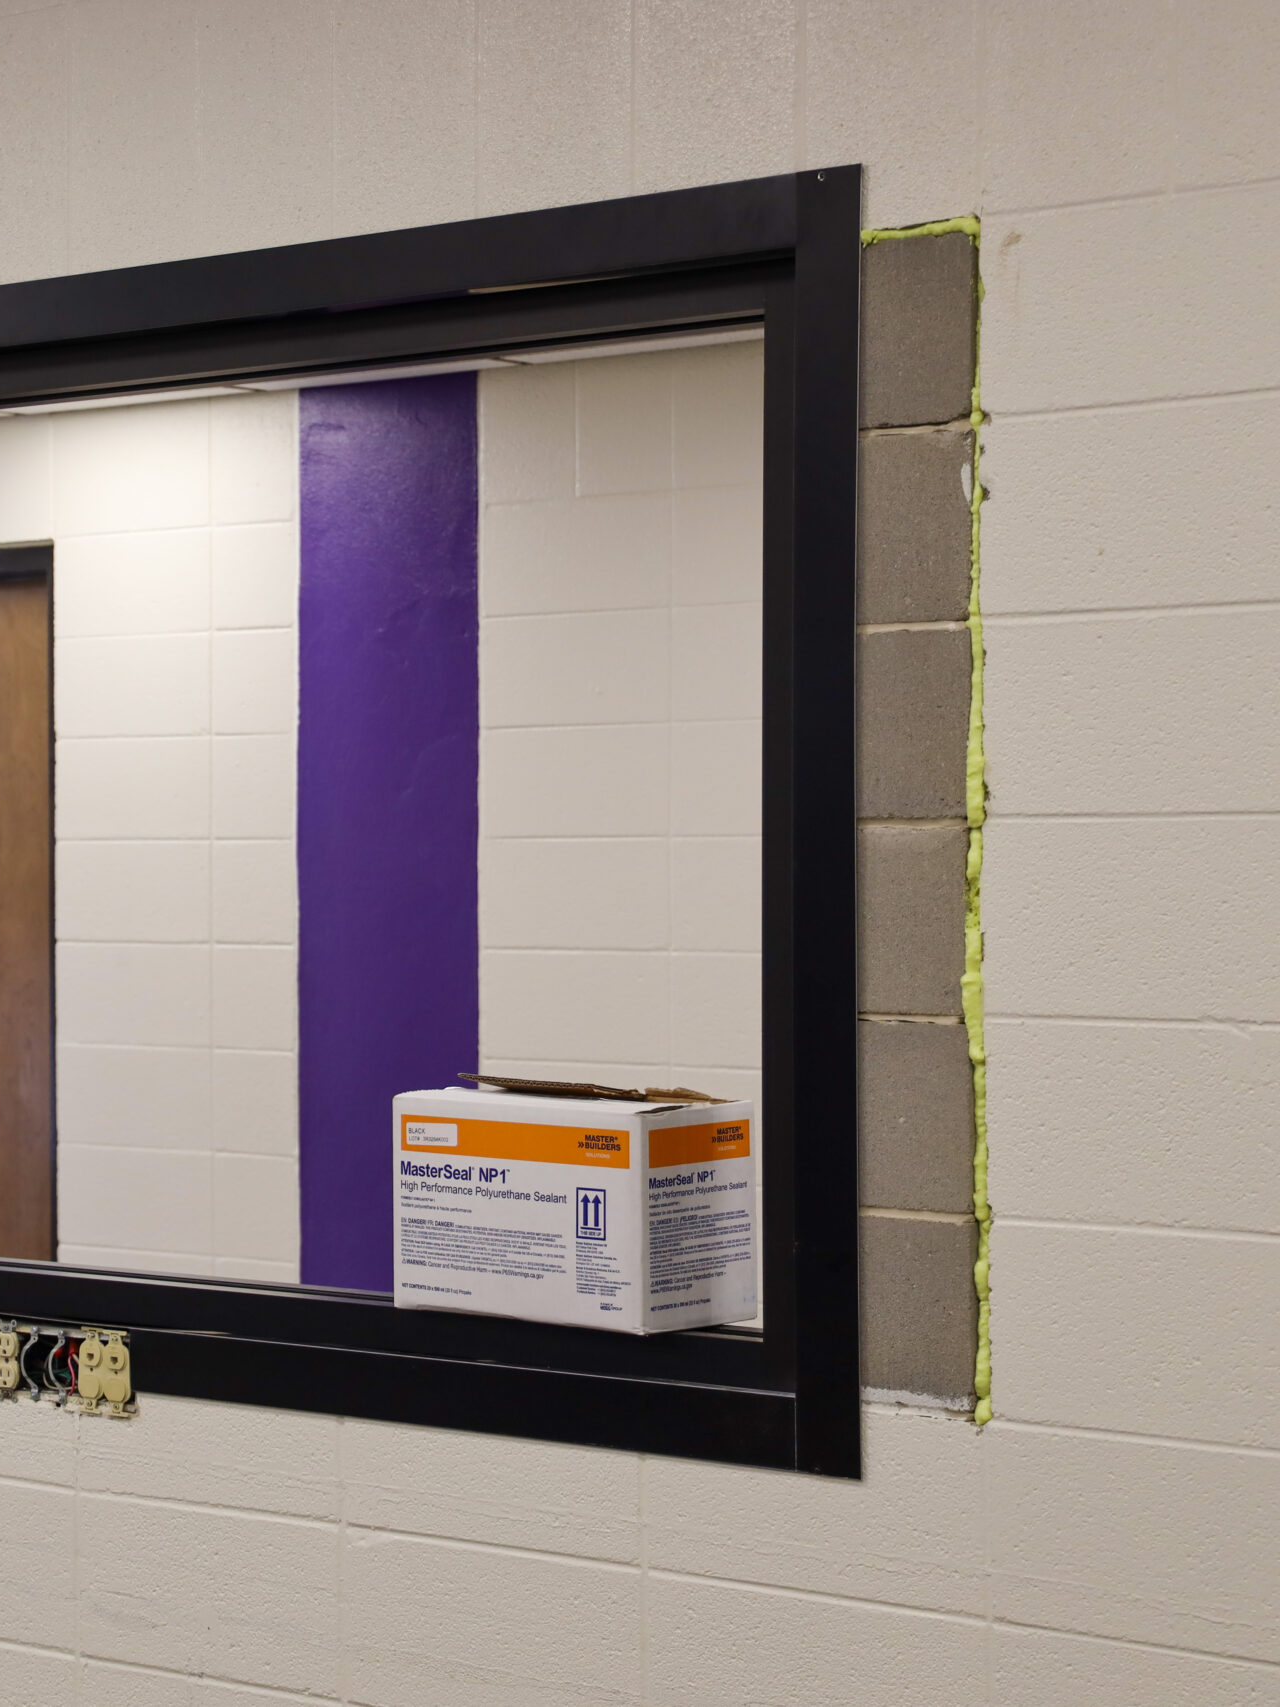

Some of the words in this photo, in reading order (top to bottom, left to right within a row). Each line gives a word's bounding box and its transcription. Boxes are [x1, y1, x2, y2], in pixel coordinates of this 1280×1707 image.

[408, 1127, 426, 1135] BLACK
[717, 1133, 744, 1143] BUILDERS
[585, 1142, 621, 1151] BUILDERS
[400, 1180, 419, 1193] High
[420, 1182, 473, 1196] Performance
[475, 1187, 531, 1201] Polyurethane
[533, 1191, 568, 1204] Sealant
[648, 1193, 661, 1202] High
[662, 1188, 695, 1200] Performance
[695, 1184, 728, 1196] Polyurethane
[728, 1181, 748, 1190] Sealant
